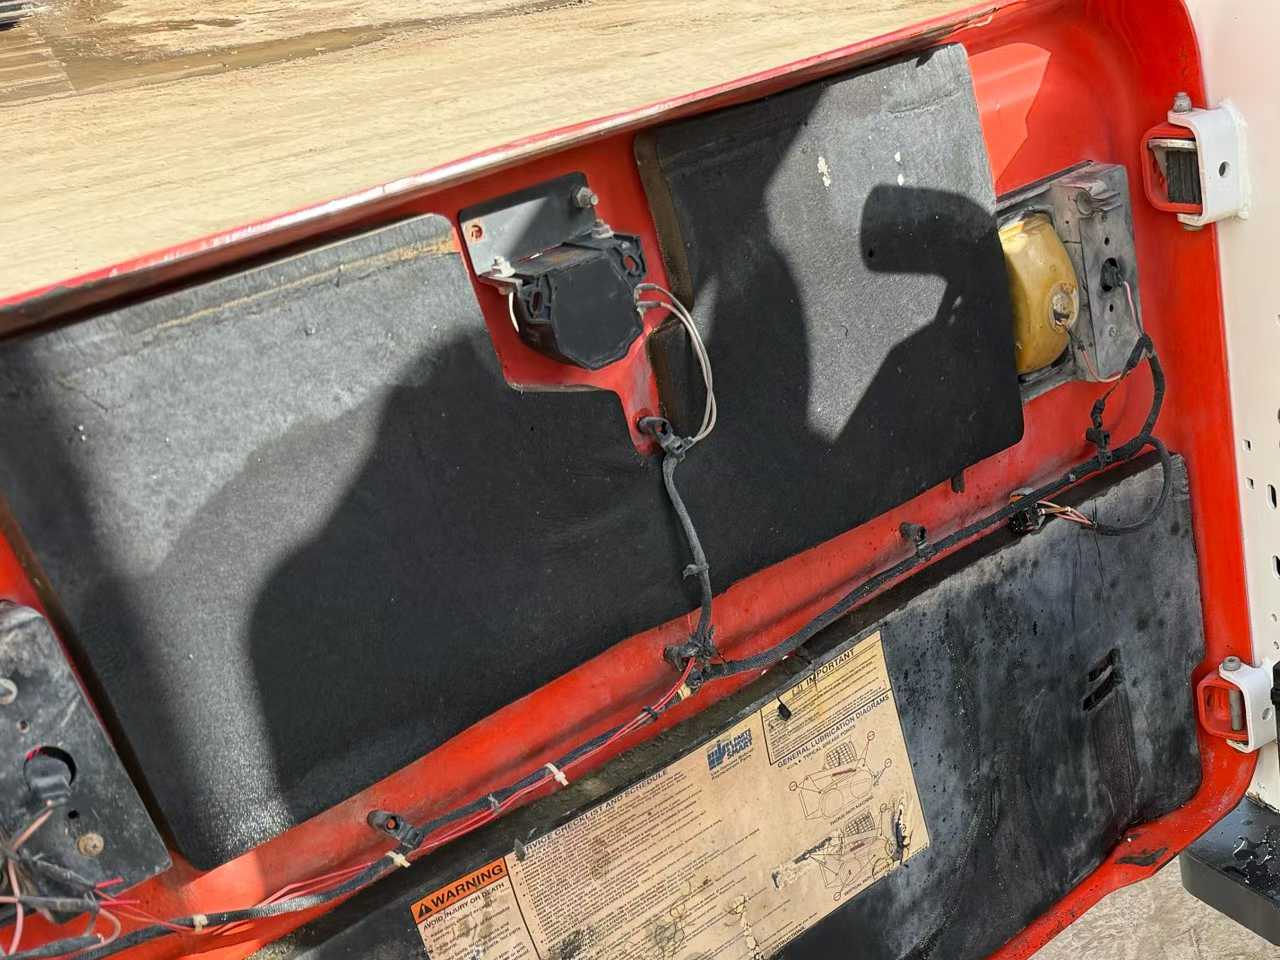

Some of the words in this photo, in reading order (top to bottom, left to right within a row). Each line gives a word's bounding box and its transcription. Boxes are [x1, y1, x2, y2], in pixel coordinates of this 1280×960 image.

[806, 648, 855, 686] IMPORTANT
[777, 744, 809, 768] GENERAL
[810, 716, 855, 749] LUBRICATION
[855, 694, 890, 720] DIAGRAMS
[554, 804, 602, 836] CHECKLIST
[605, 793, 623, 809] AND
[624, 770, 666, 797] SCHEDULE
[423, 914, 443, 930] AVOID
[444, 901, 468, 920] INJURY
[470, 894, 481, 904] OR
[482, 882, 505, 898] DEATH
[431, 864, 503, 908] WARNING
